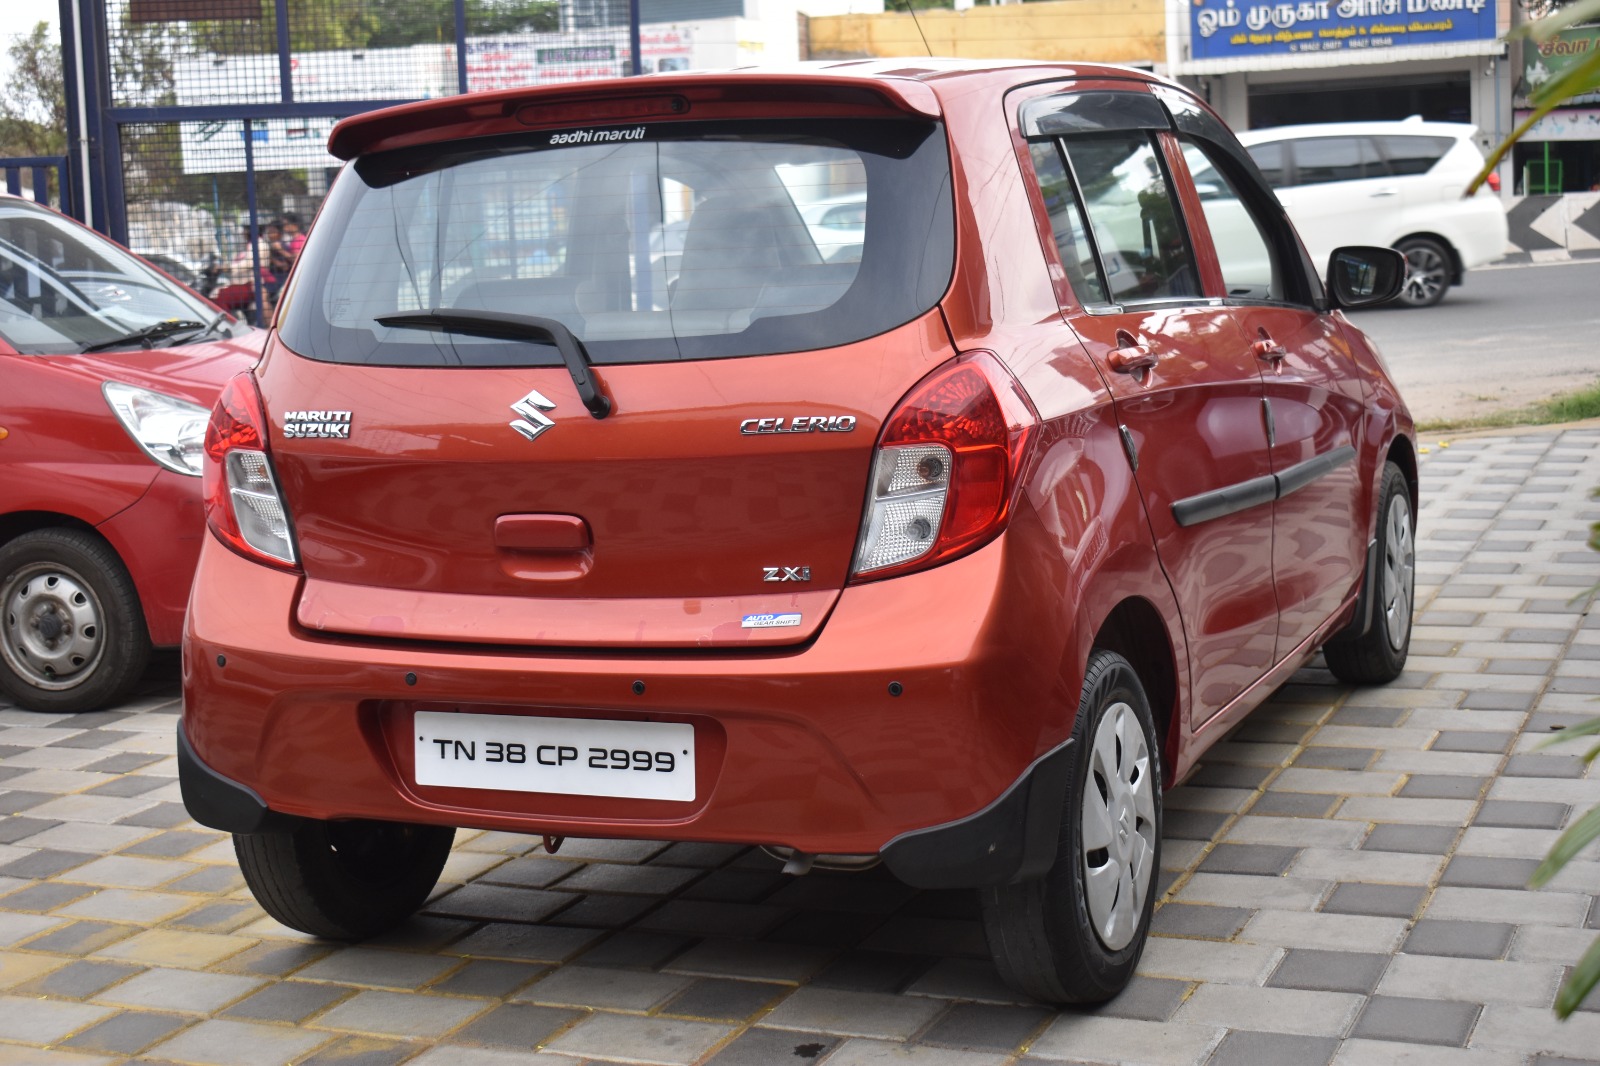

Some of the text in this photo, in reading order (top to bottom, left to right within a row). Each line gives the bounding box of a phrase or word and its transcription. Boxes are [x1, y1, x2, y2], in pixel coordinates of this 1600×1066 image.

[1197, 0, 1241, 37] ஓம்
[550, 127, 646, 144] aadhi maruti
[284, 411, 352, 422] MARUTI
[740, 416, 856, 434] CELERIO
[283, 423, 350, 438] SUZUKI
[763, 566, 810, 581] ZXi
[433, 739, 676, 773] TN 38 CP 2999
